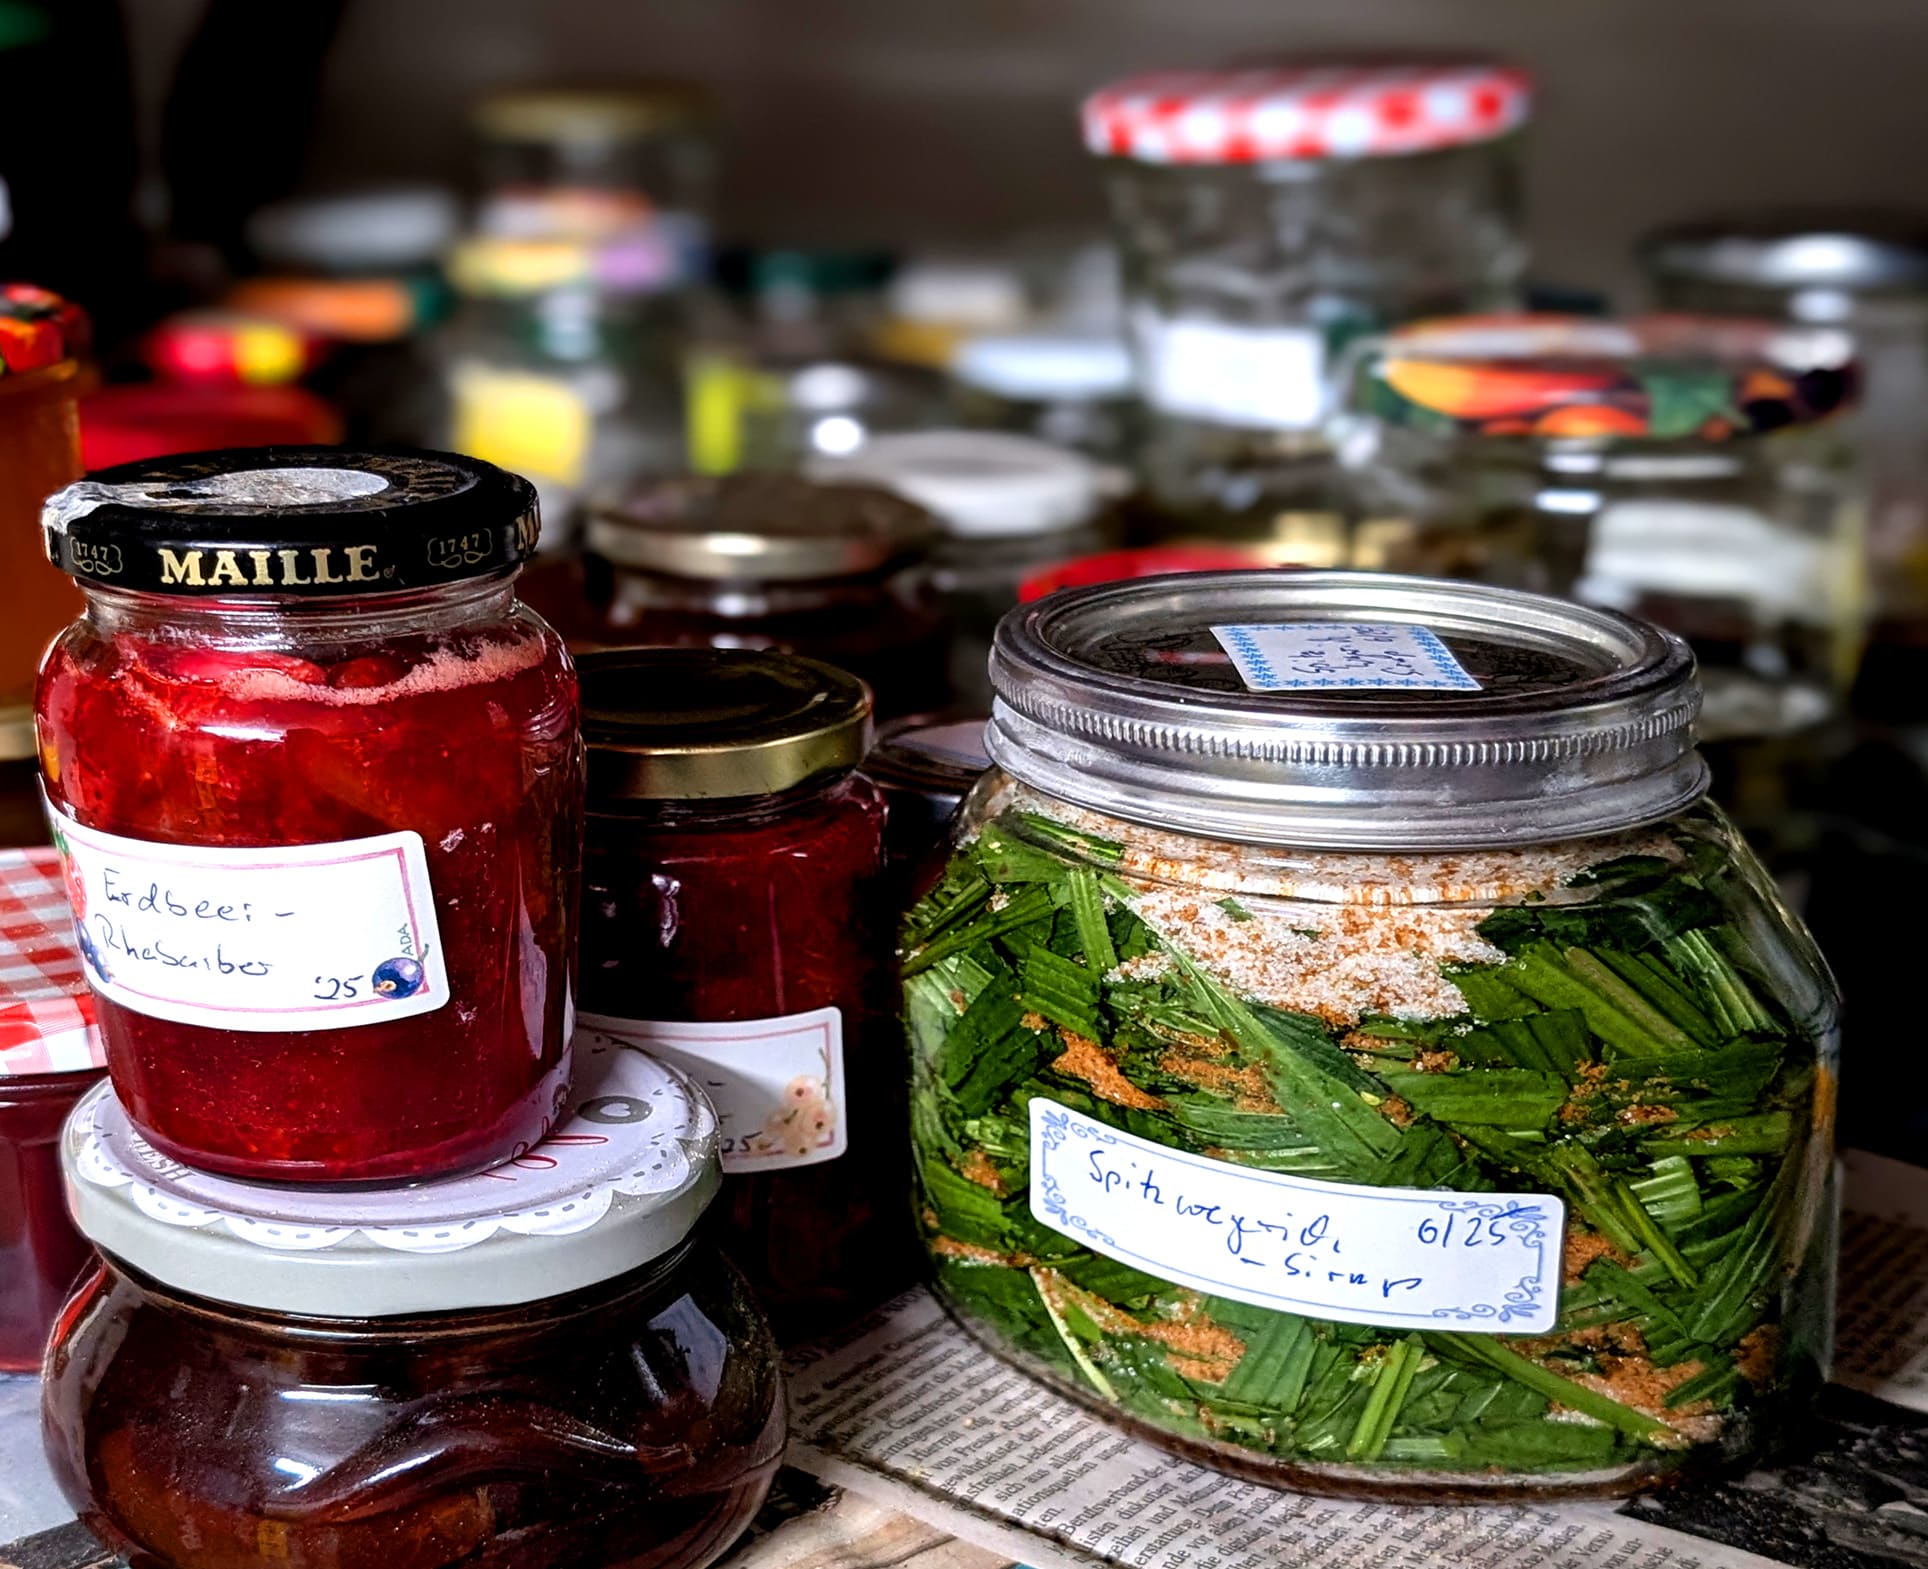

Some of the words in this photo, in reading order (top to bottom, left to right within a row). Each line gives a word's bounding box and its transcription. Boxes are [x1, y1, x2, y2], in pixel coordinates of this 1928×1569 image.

[76, 540, 109, 561] 1747
[438, 532, 481, 555] 1747
[158, 545, 382, 587] MAILLE
[398, 922, 414, 956] ADA
[1017, 1427, 1044, 1442] der
[930, 1456, 960, 1470] von
[994, 1482, 1026, 1502] sich
[1023, 1469, 1050, 1484] aus
[1055, 1474, 1148, 1534] Berufsverband
[1146, 1504, 1178, 1525] und
[1186, 1534, 1213, 1550] vor
